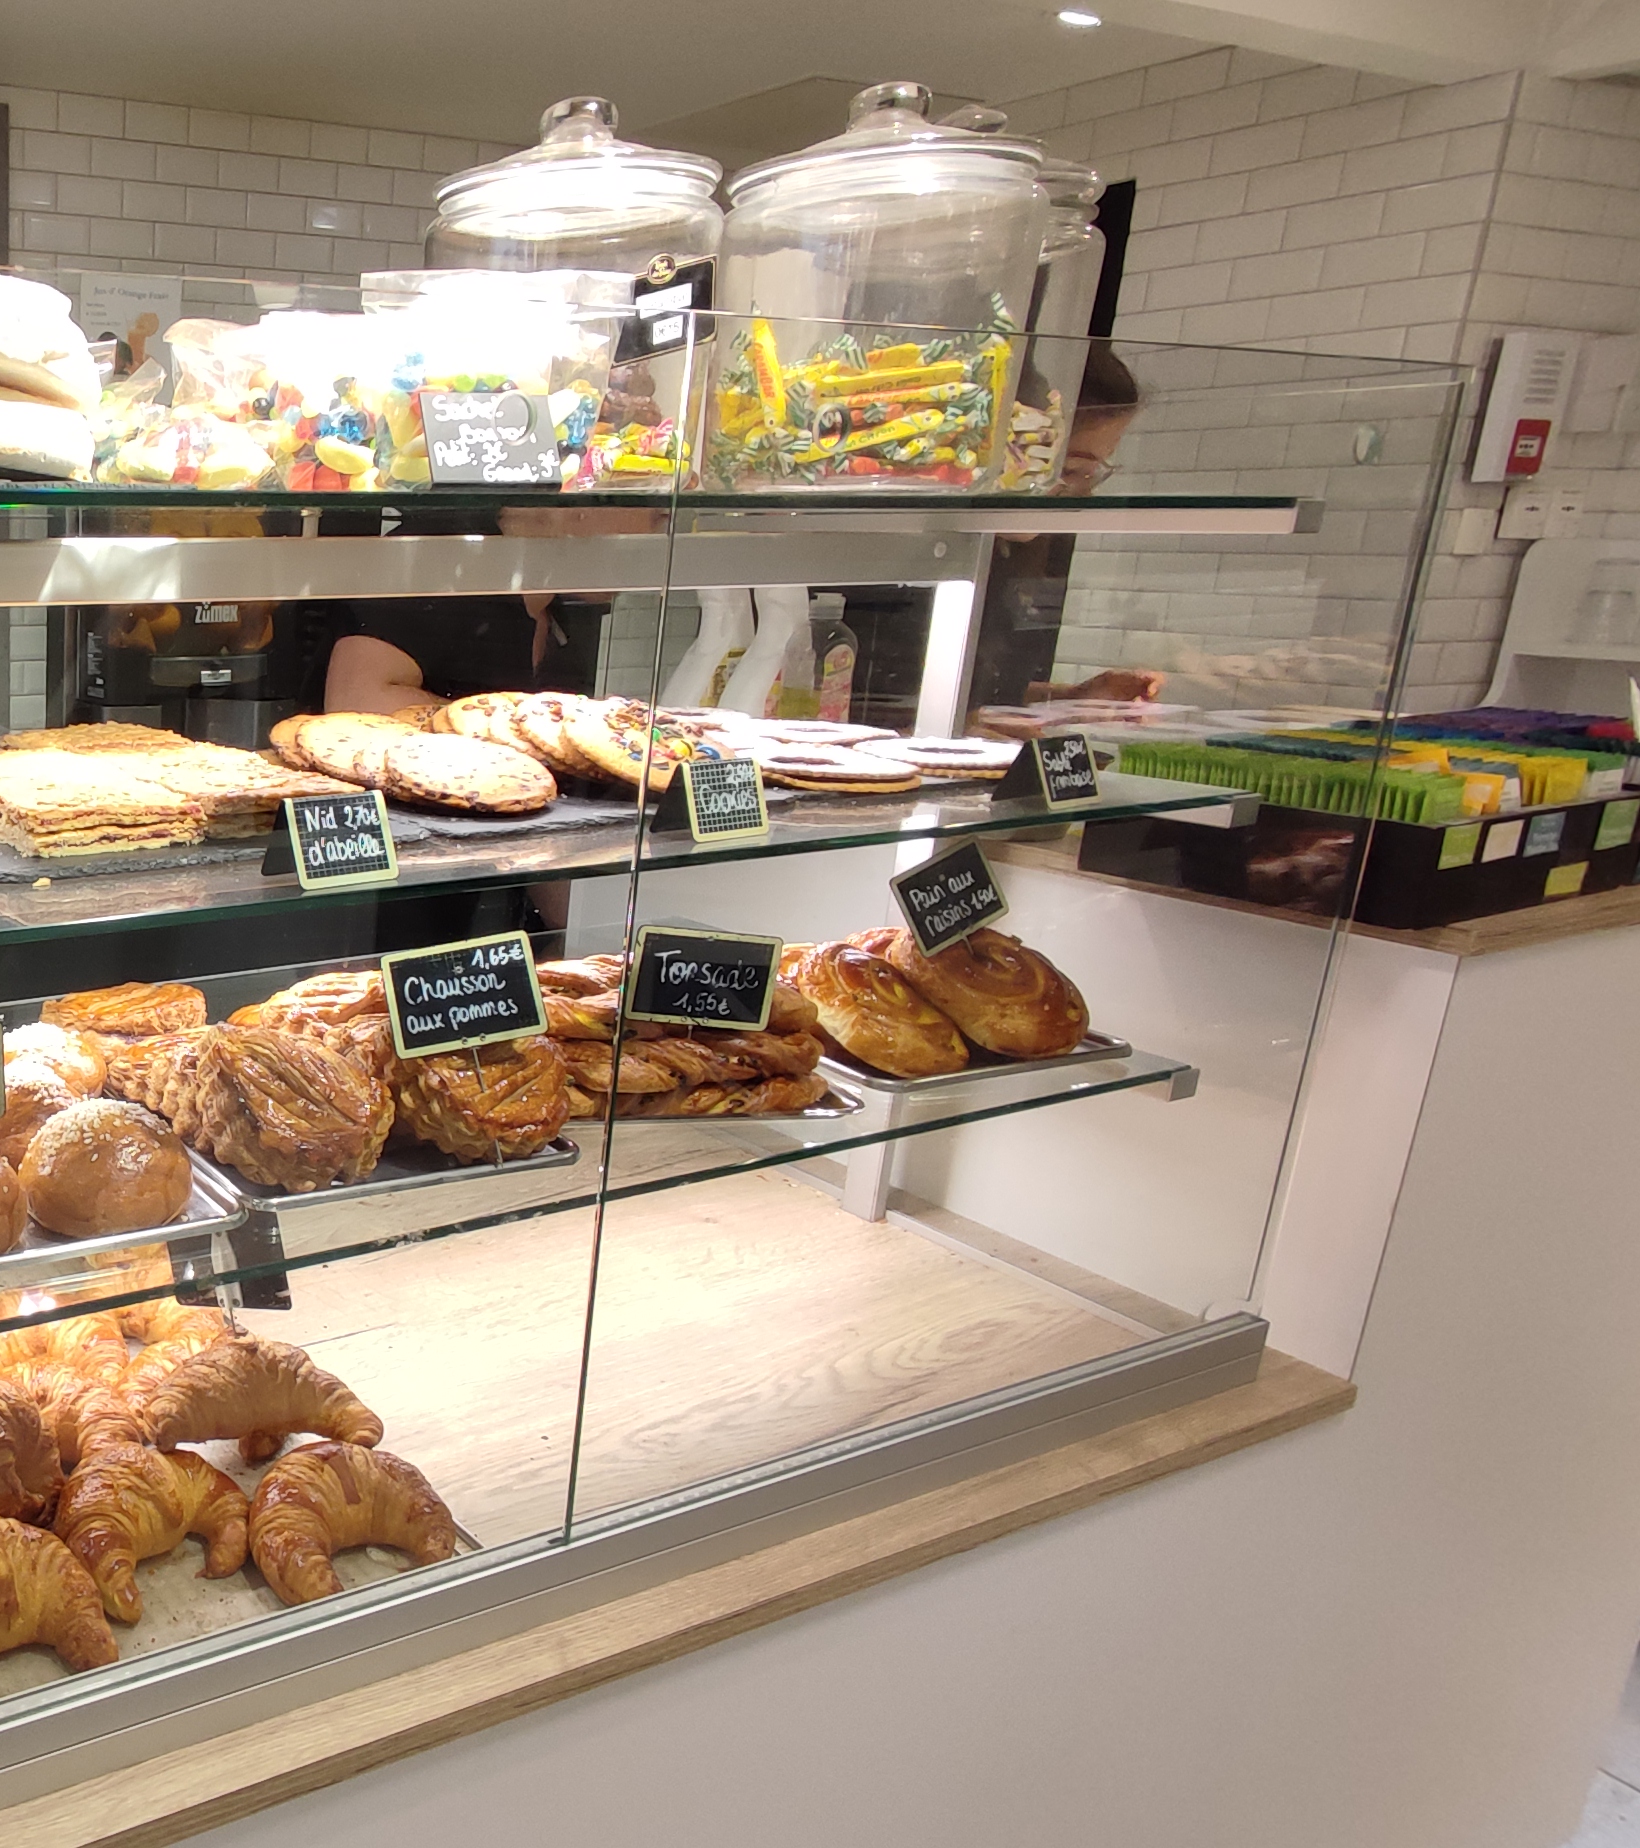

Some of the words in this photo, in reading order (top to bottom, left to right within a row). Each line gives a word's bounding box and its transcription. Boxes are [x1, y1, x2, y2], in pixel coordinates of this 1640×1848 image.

[700, 784, 757, 814] Cookies
[304, 806, 338, 832] Nid
[309, 832, 386, 866] d'abeille
[909, 885, 947, 912] Pain
[948, 870, 976, 894] aux
[924, 899, 972, 937] raisins
[654, 949, 759, 990] Torsade
[404, 973, 507, 1006] Chausson
[672, 992, 731, 1016] 1,55€
[406, 1012, 445, 1034] aux
[448, 999, 519, 1031] pommes
